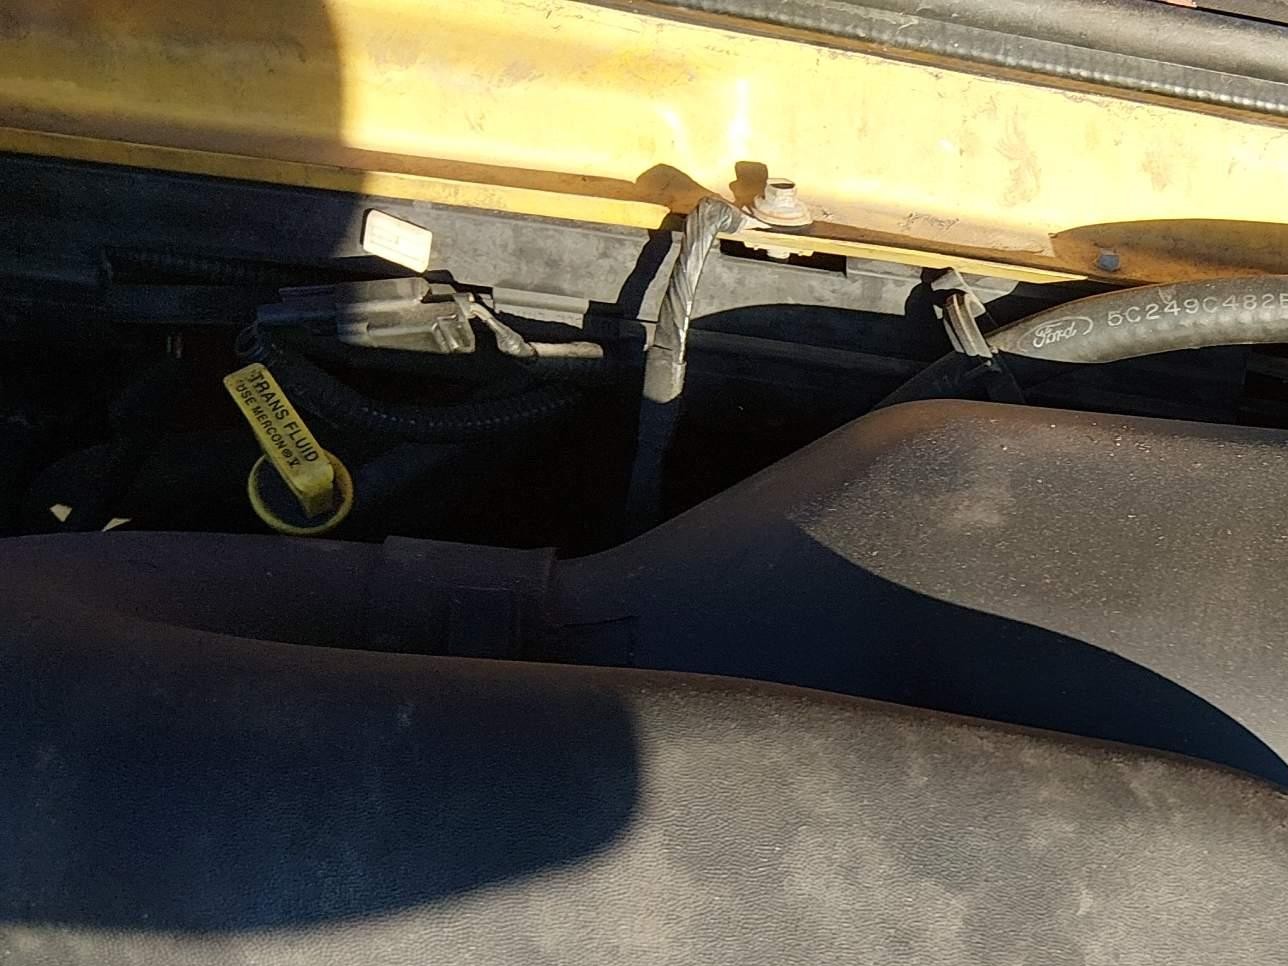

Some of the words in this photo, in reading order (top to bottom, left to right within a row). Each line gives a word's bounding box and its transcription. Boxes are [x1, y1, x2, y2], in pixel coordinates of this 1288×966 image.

[1033, 320, 1077, 348] Ford
[236, 383, 257, 406] USE
[248, 371, 290, 420] TRANS
[283, 421, 319, 462] FLUID
